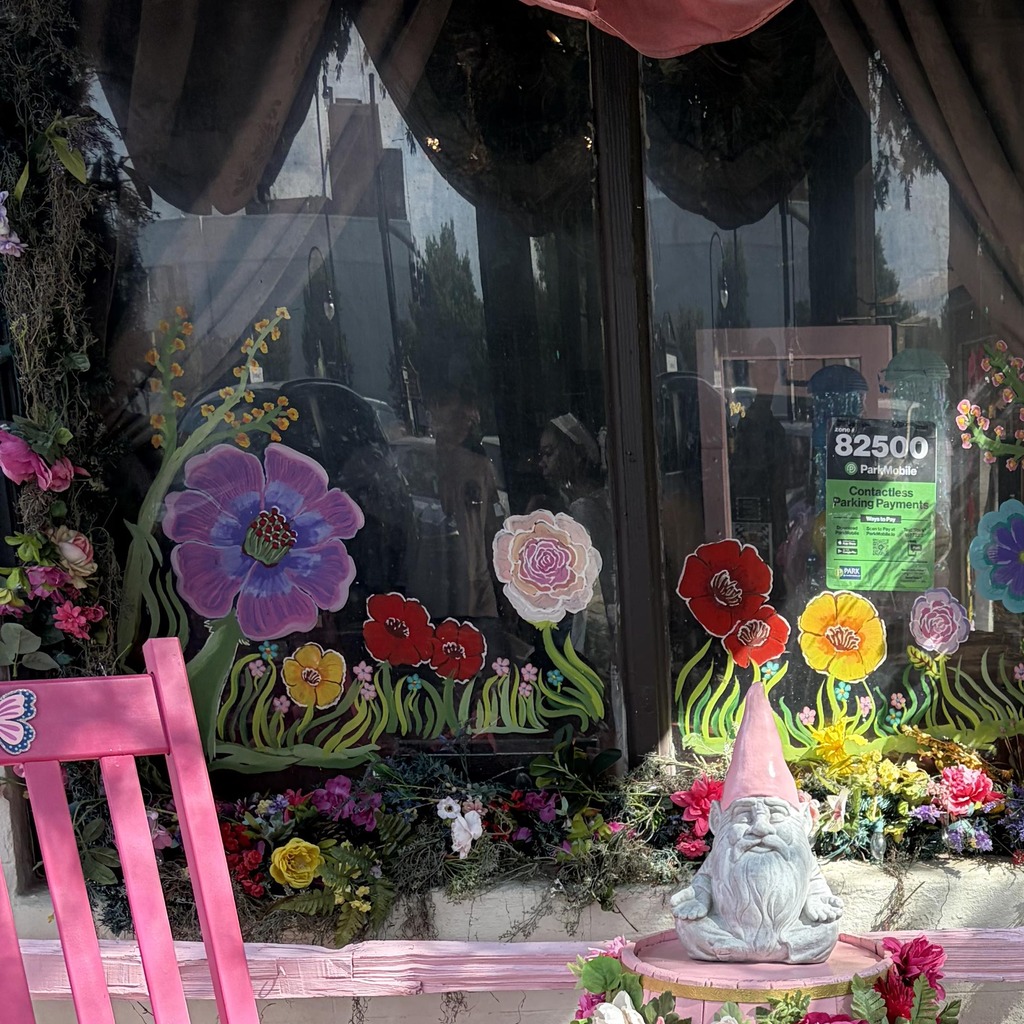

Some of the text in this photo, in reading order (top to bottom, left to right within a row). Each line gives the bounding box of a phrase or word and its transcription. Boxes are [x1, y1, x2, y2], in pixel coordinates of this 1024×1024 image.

[834, 433, 929, 459] 82500
[860, 464, 918, 476] ParkMobile
[849, 486, 914, 498] Contactless
[833, 497, 929, 510] Parking Payments
[844, 567, 860, 575] PARK
